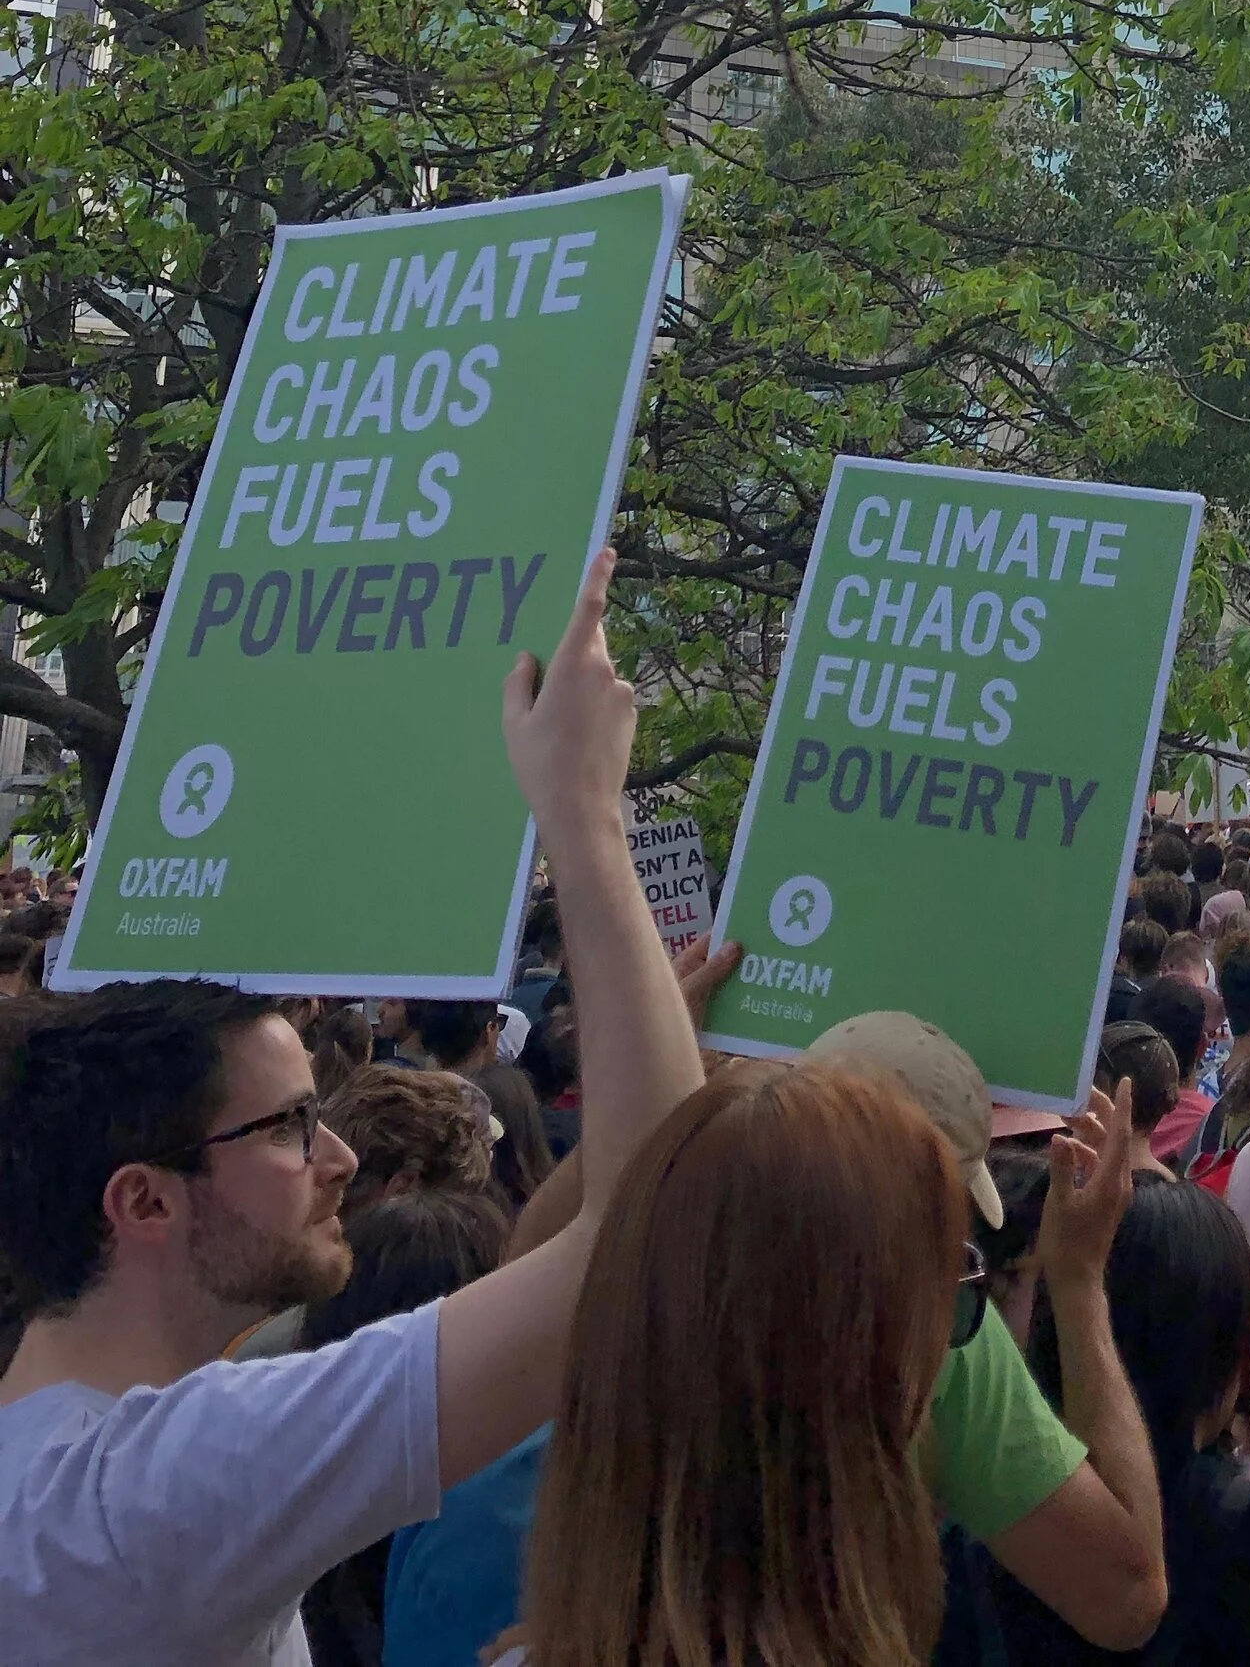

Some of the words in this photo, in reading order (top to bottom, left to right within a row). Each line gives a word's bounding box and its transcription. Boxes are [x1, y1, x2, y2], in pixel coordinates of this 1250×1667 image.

[284, 231, 597, 343] CLIMATE
[253, 343, 500, 444] CHAOS
[219, 450, 461, 548] FUELS
[847, 495, 1127, 588] CLIMATE
[187, 553, 548, 658] POVERTY
[826, 574, 1048, 663] CHAOS
[804, 655, 1018, 747] FUELS
[784, 738, 1100, 848] POVERTY
[626, 820, 699, 852] DENIAL
[119, 857, 229, 899] OXFAM
[634, 851, 681, 879] SN'T
[687, 848, 702, 868] A
[644, 873, 704, 904] OLICY
[116, 910, 202, 938] Australia
[651, 901, 699, 927] TELL
[663, 931, 697, 956] HE
[739, 954, 832, 997] OXFAM
[739, 995, 814, 1024] Australia
